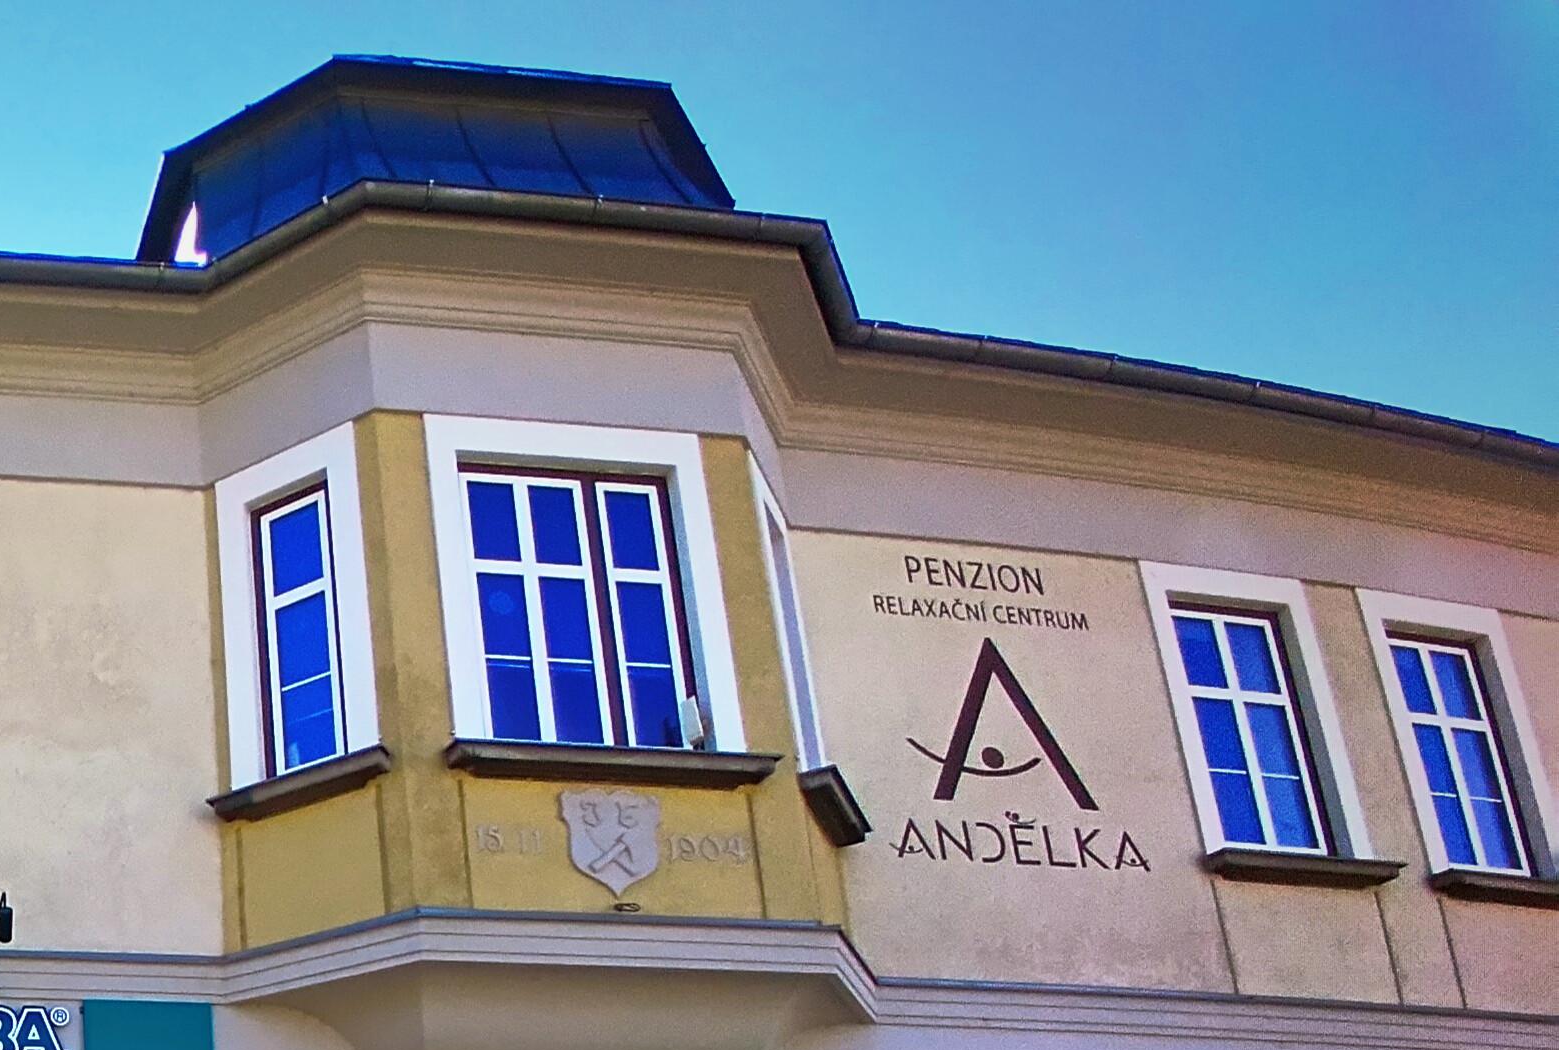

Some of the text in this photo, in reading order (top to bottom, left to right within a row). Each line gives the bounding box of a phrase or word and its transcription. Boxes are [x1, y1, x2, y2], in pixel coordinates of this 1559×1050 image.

[904, 555, 1045, 596] PENZION
[872, 594, 1090, 631] RELAXAČNÍ CENTRUM
